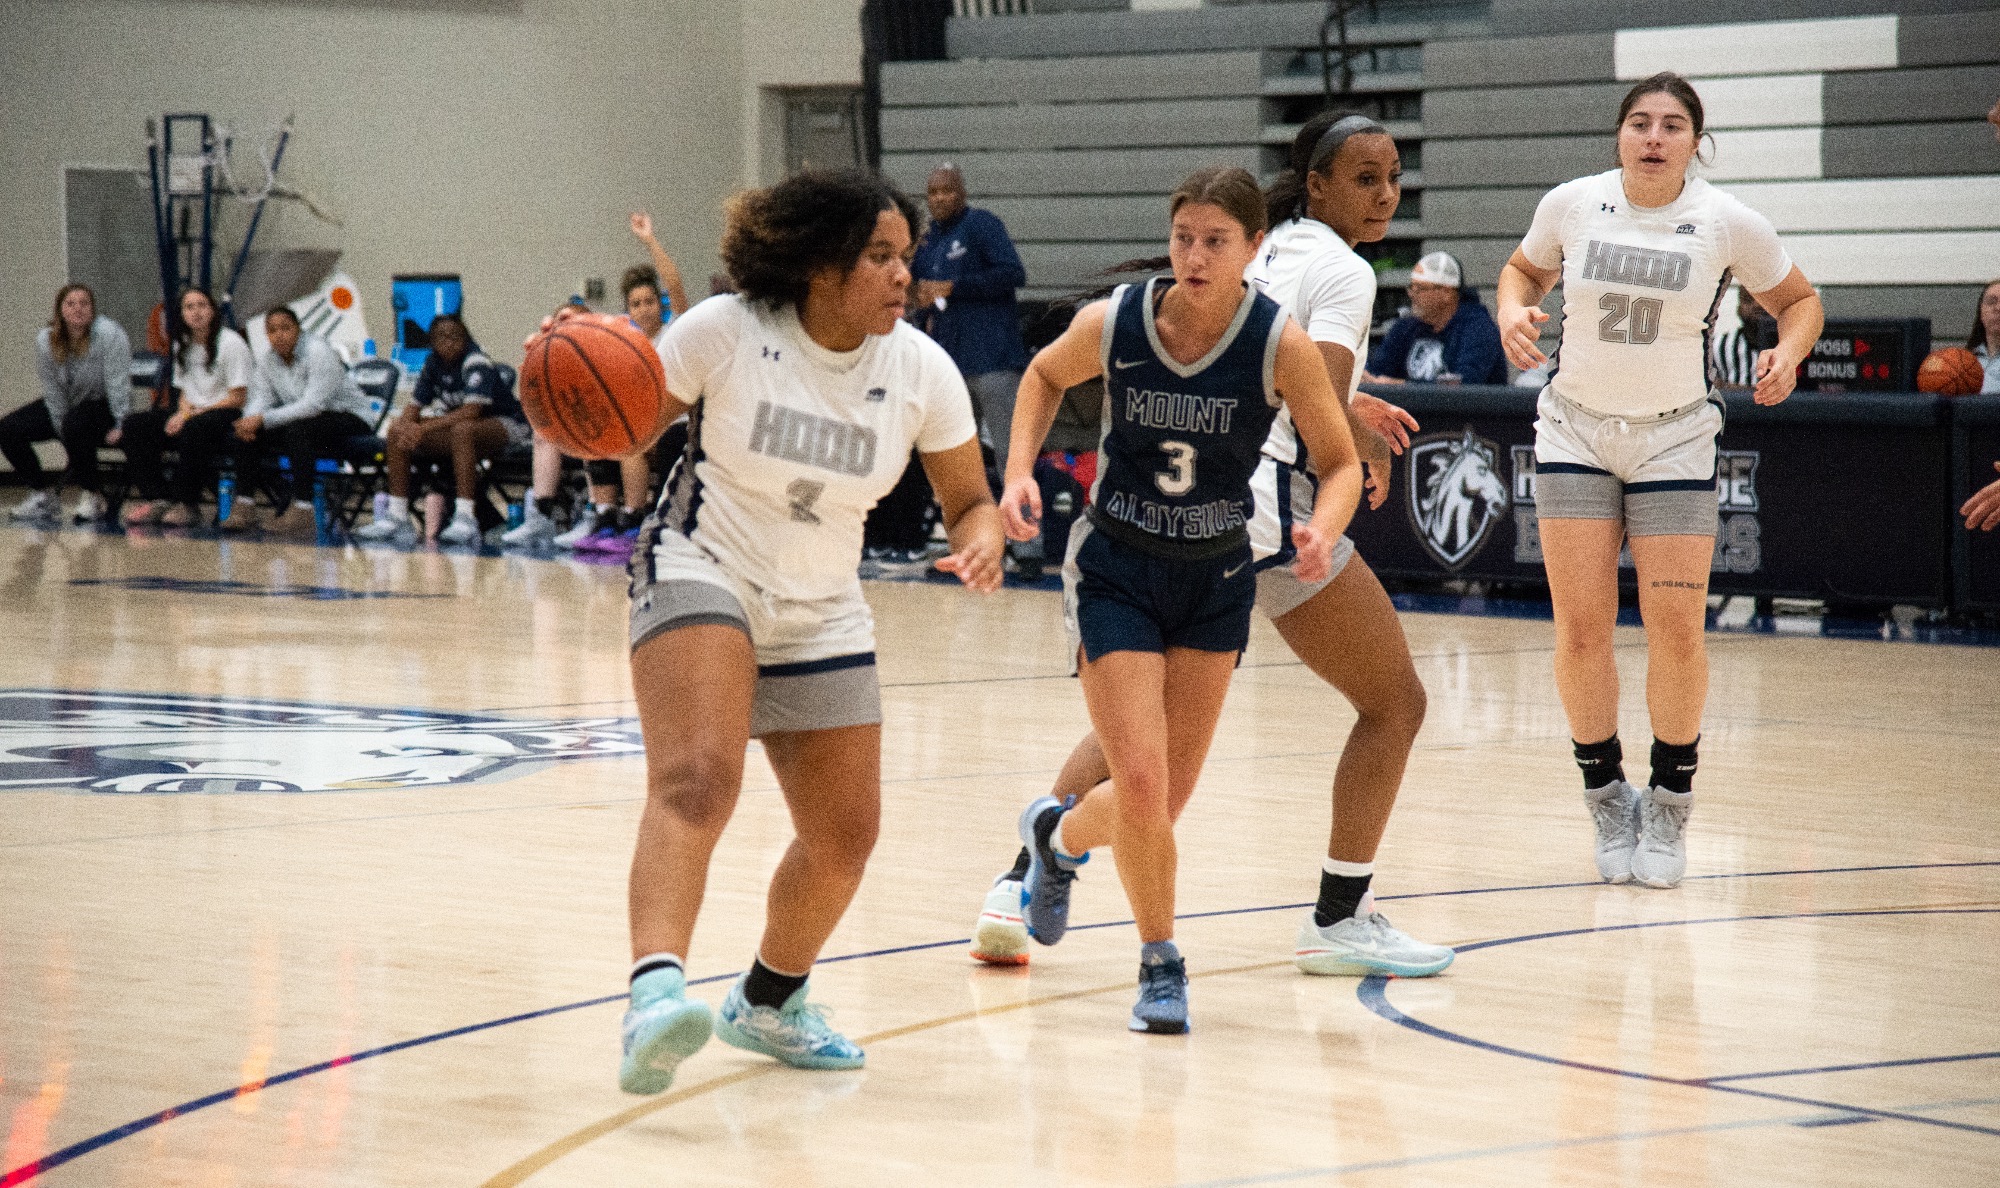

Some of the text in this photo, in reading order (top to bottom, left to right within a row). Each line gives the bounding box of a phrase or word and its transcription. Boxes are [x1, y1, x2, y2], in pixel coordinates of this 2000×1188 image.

[1582, 240, 1692, 292] HOOD
[1599, 292, 1664, 345] 20
[1807, 361, 1857, 379] BONUS
[1814, 339, 1851, 356] POSS
[1125, 386, 1239, 434] MOUNT
[748, 400, 879, 479] HOOD
[1154, 439, 1198, 497] 3
[1105, 490, 1248, 539] ALOYSIUS
